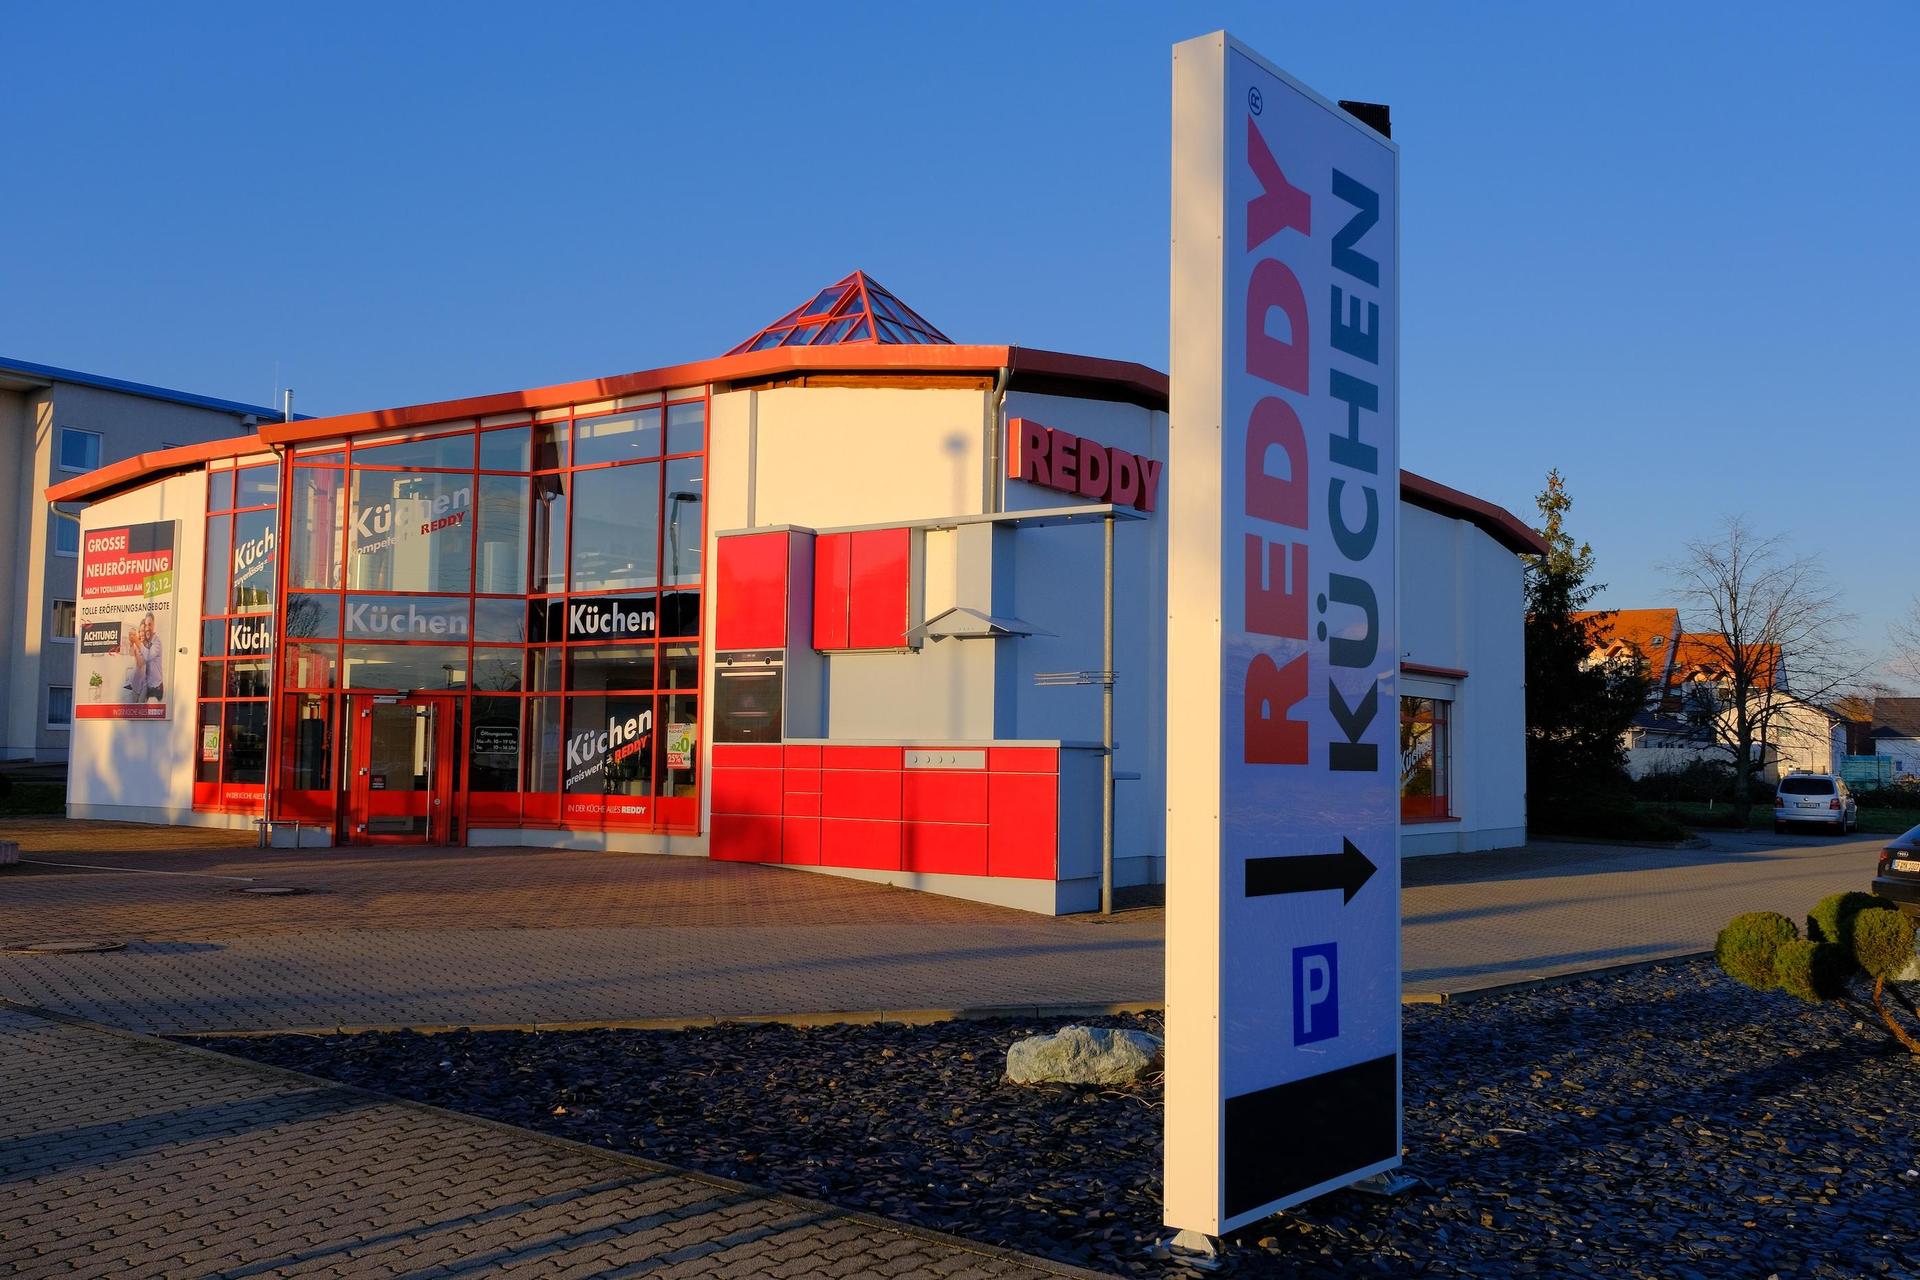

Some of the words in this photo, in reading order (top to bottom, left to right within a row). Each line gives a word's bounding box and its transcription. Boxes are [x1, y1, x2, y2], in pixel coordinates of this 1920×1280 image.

[1008, 418, 1163, 512] REDDY
[1317, 167, 1379, 772] KÜCHEN
[421, 511, 465, 535] REDDY
[87, 535, 126, 553] GROSSE
[86, 557, 169, 578] NEUERÖFFNUNG
[84, 586, 100, 595] NACH
[100, 584, 133, 594] TOTALUMBAU
[134, 583, 143, 592] AM
[82, 607, 98, 616] TOLLE
[99, 601, 170, 615] ERÖFFNUNGSANGEBOTE
[346, 603, 468, 634] Küchen
[569, 602, 655, 634] Küchen
[83, 630, 118, 641] ACHTUNG!
[566, 709, 652, 771] Küchen
[566, 760, 604, 790] preiswert
[614, 735, 648, 761] REDDY
[568, 804, 575, 812] IN
[575, 804, 586, 813] DER
[621, 806, 646, 815] REDDY
[1302, 954, 1330, 1034] P
